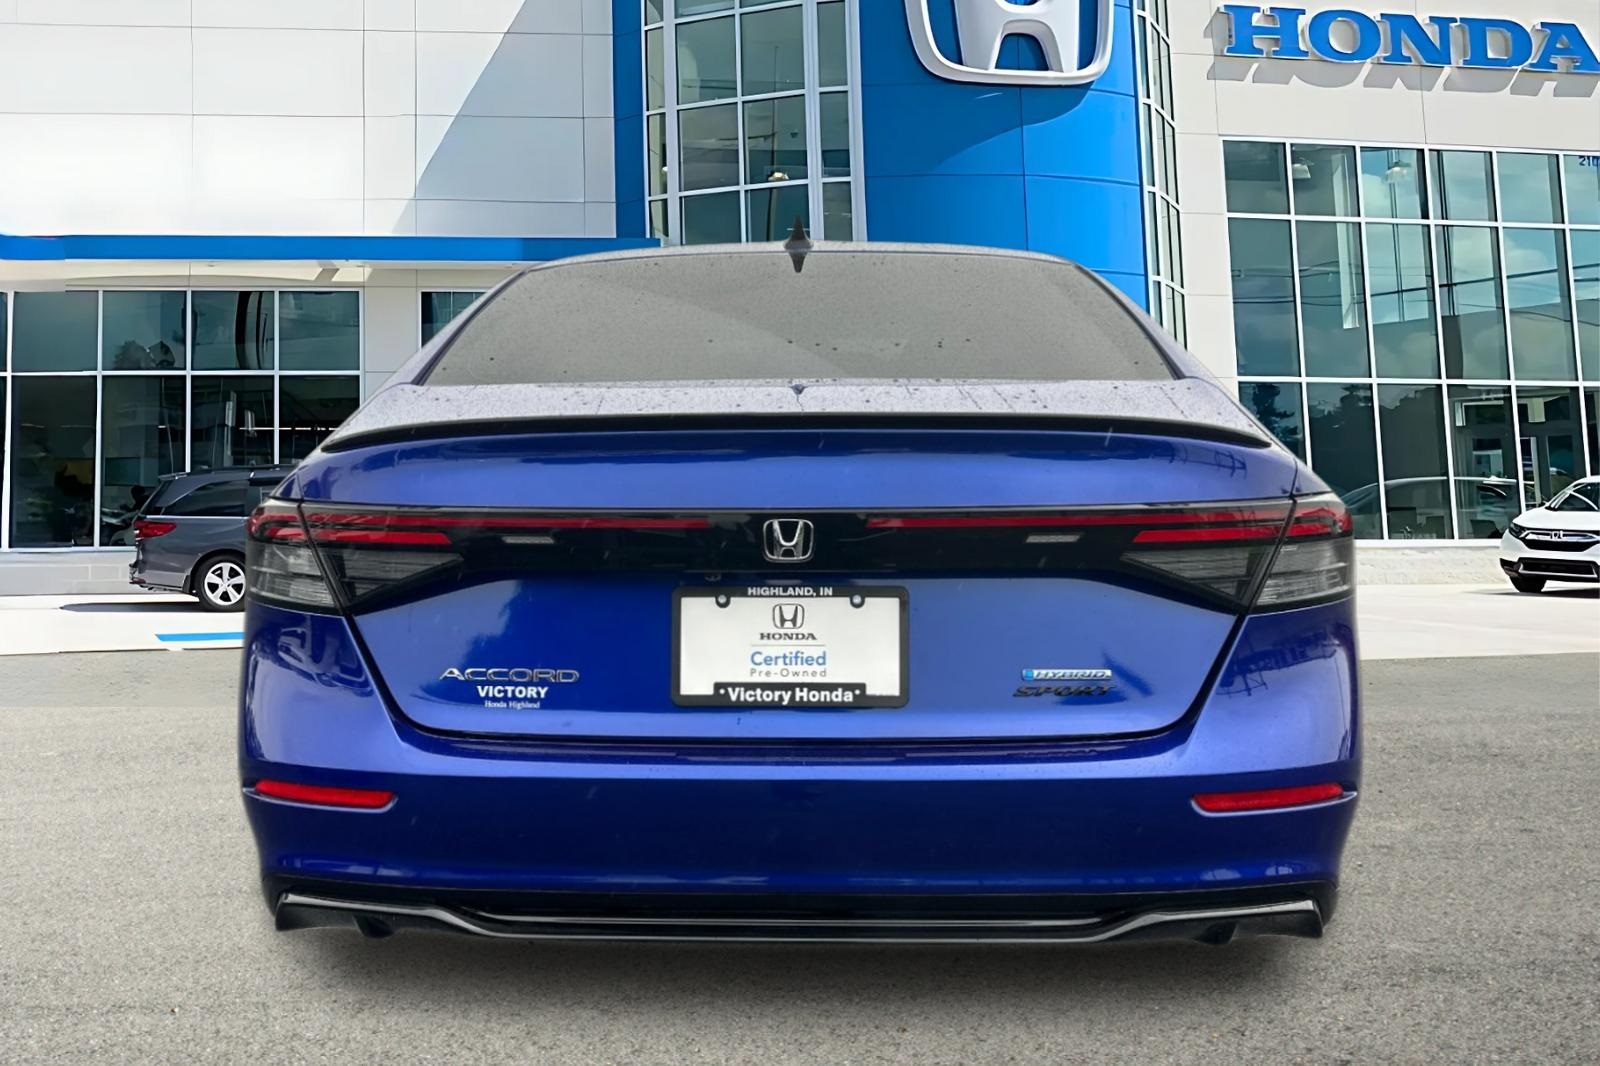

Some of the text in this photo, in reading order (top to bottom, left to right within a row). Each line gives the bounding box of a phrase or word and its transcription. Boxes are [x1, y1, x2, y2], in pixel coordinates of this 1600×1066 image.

[1222, 4, 1600, 73] HONDA
[747, 587, 833, 597] HIGHLAND, IN
[759, 632, 817, 641] HONDA
[750, 651, 827, 666] Certified
[439, 668, 580, 683] ACCORD
[750, 668, 827, 678] Pre-Owned
[1035, 670, 1107, 680] HYBRID
[476, 685, 549, 698] VICTORY
[727, 687, 854, 705] Victory Honda
[1012, 685, 1117, 698] SPORT
[509, 701, 540, 709] Highland
